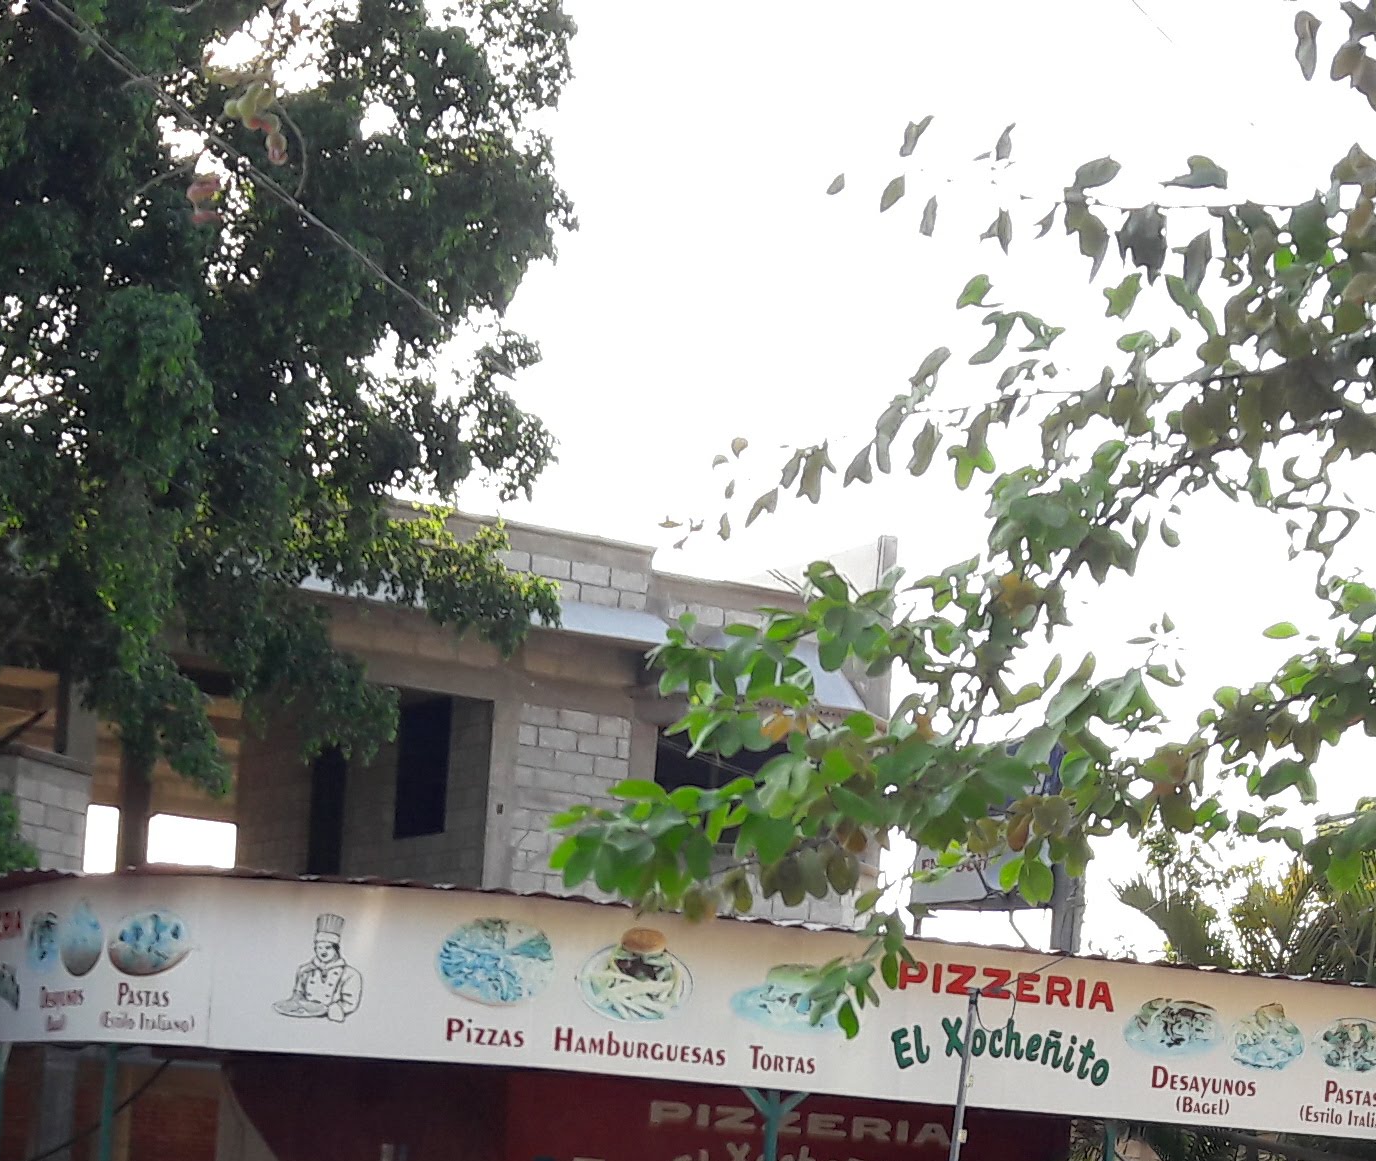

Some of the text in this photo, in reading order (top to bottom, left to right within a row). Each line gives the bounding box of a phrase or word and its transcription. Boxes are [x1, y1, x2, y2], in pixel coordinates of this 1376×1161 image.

[899, 960, 1114, 1013] PIZZERIA
[891, 1016, 1110, 1087] El Xocheñito
[649, 1101, 952, 1148] PIZZERIA
